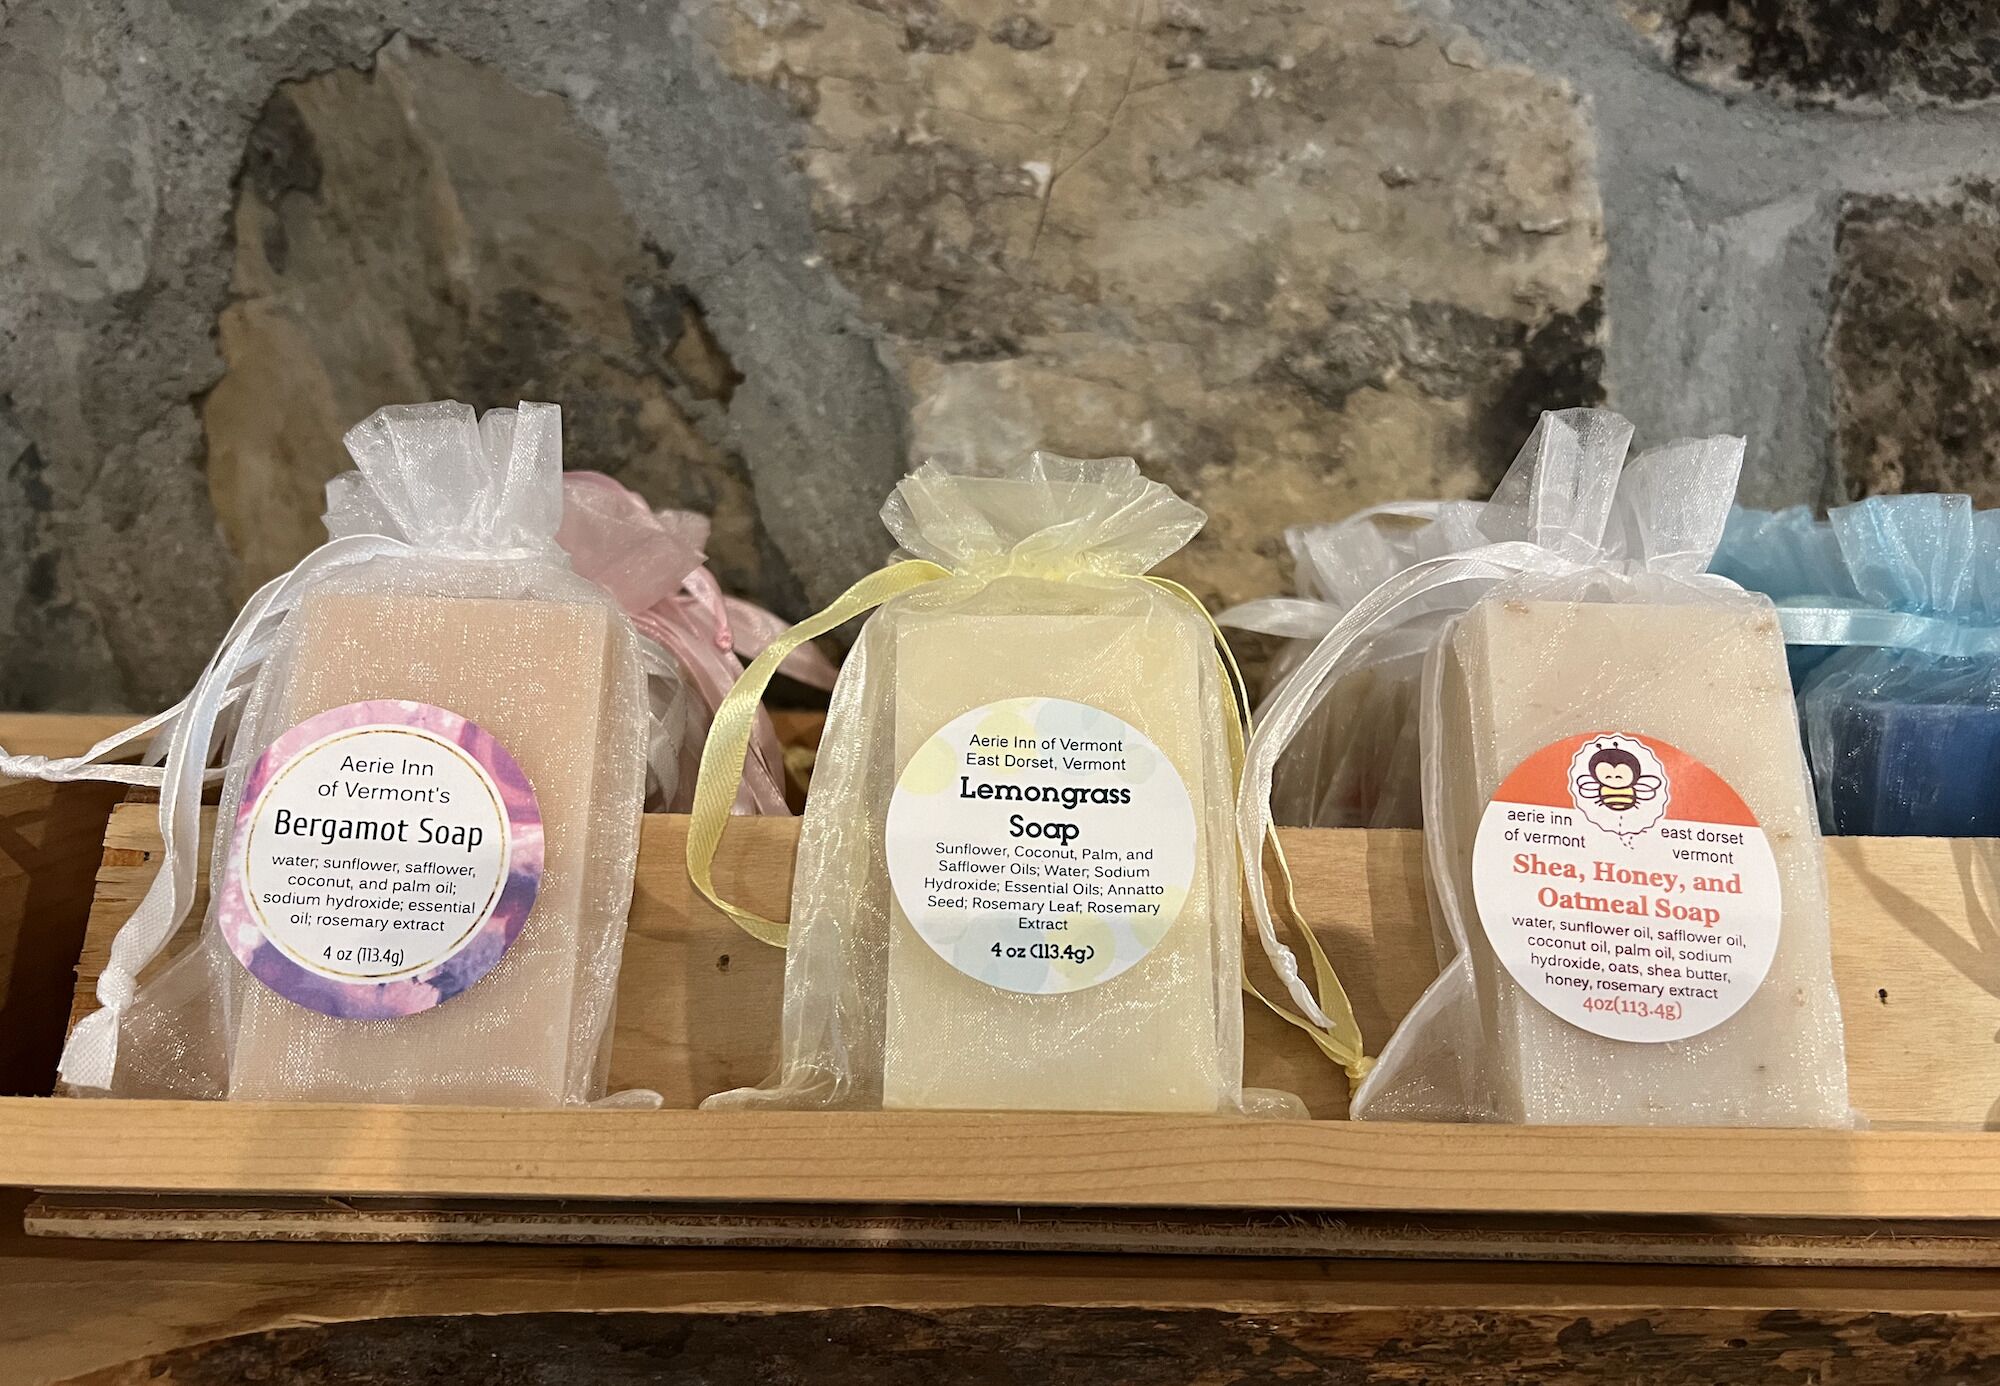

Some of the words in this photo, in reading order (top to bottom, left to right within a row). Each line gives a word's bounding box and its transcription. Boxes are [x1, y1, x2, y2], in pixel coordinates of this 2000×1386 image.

[969, 734, 1009, 748] Aerie
[1014, 736, 1036, 749] Inn
[1041, 737, 1056, 750] of
[1060, 738, 1122, 752] Vermont
[340, 756, 394, 774] Aerie
[402, 759, 434, 776] Inn
[966, 753, 1000, 767] East
[1005, 754, 1058, 770] Dorset,
[1062, 757, 1126, 771] Vermont
[318, 781, 339, 797] of
[346, 782, 451, 804] Vermont's
[960, 776, 1131, 809] Lemongrass
[1507, 810, 1545, 824] aerie
[1551, 812, 1572, 826] inn
[274, 809, 409, 845] Bergamot
[417, 819, 483, 852] Soap
[1009, 814, 1080, 845] Soap
[1504, 828, 1521, 842] of
[1524, 830, 1585, 849] vermont
[1661, 826, 1693, 840] east
[1697, 828, 1744, 845] dorset
[936, 842, 1010, 858] Sunflower,
[1014, 846, 1077, 861] Coconut,
[1082, 848, 1121, 862] Palm,
[1126, 848, 1153, 861] and
[1672, 849, 1734, 864] vermont
[272, 855, 319, 869] water;
[323, 856, 400, 874] sunflower,
[405, 862, 477, 878] safflower,
[939, 860, 1005, 874] Safflower
[1010, 863, 1040, 877] Oils;
[1044, 865, 1090, 879] Water;
[1094, 866, 1150, 878] Sodium
[1513, 853, 1585, 883] Shea,
[1593, 861, 1686, 893] Honey,
[1693, 873, 1742, 894] and
[288, 875, 353, 891] coconut,
[359, 879, 388, 891] and
[392, 881, 430, 896] palm
[435, 881, 457, 895] oil;
[924, 878, 1000, 894] Hydroxide;
[1005, 881, 1068, 894] Essential
[1073, 883, 1103, 896] Oils;
[1107, 884, 1164, 896] Annatto
[263, 892, 320, 907] sodium
[326, 895, 404, 912] hydroxide;
[408, 901, 475, 914] essential
[927, 896, 968, 910] Seed;
[973, 898, 1045, 915] Rosemary
[1049, 900, 1083, 914] Leaf;
[1087, 902, 1160, 916] Rosemary
[1538, 887, 1649, 916] Oatmeal
[1655, 898, 1720, 928] Soap
[290, 913, 312, 926] oil;
[317, 915, 389, 931] rosemary
[393, 919, 445, 932] extract
[1019, 917, 1068, 931] Extract
[1512, 916, 1556, 930] water,
[1560, 920, 1629, 937] sunflower
[1634, 926, 1653, 940] oil,
[1658, 929, 1721, 945] safflower
[1727, 934, 1746, 948] oil,
[323, 946, 331, 960] 4
[337, 950, 352, 962] oz
[357, 946, 405, 966] (113.4g)
[991, 943, 1002, 957] 4
[1006, 946, 1026, 958] oz
[1030, 943, 1094, 964] (113.4g)
[1527, 936, 1586, 952] coconut
[1591, 940, 1610, 954] oil,
[1615, 944, 1651, 958] palm
[1655, 946, 1675, 960] oil,
[1679, 948, 1732, 964] sodium
[1531, 953, 1605, 972] hydroxide,
[1608, 961, 1643, 976] oats,
[1647, 963, 1682, 978] shea
[1686, 967, 1731, 984] butter,
[1545, 973, 1593, 991] honey,
[1597, 978, 1664, 998] rosemary
[1669, 985, 1718, 999] extract
[1583, 996, 1682, 1021] 4oz(113.4g)
